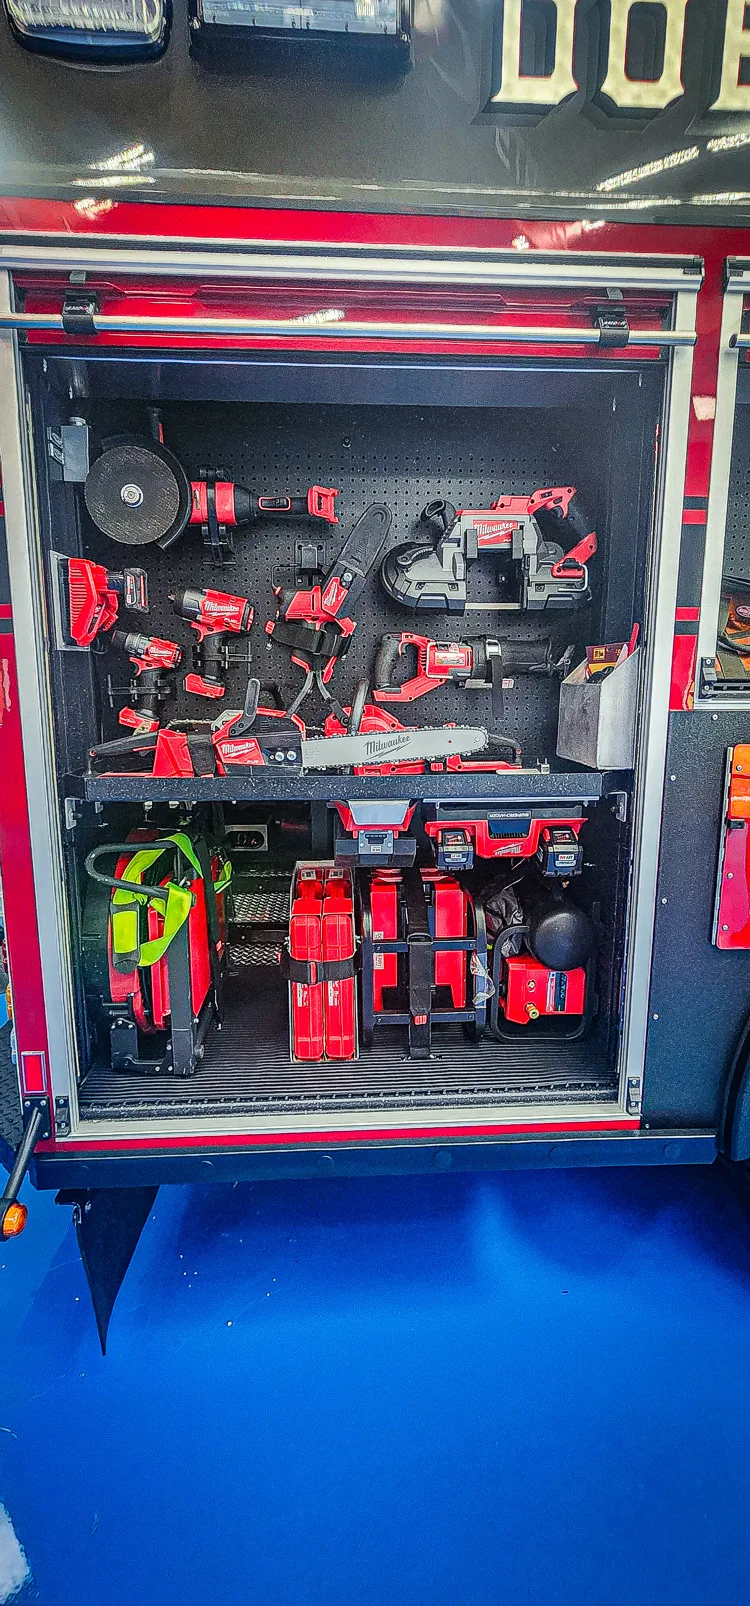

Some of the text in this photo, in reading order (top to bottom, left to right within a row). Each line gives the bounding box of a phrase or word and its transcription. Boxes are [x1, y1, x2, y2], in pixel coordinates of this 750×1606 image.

[474, 522, 514, 535] Milwaukee
[324, 582, 337, 606] Milwaukee
[204, 600, 240, 613] Milwaukee
[149, 646, 173, 655] Milwaukee
[221, 740, 256, 755] Milwaukee
[363, 734, 411, 755] Milwaukee
[495, 845, 523, 856] Milwaukee
